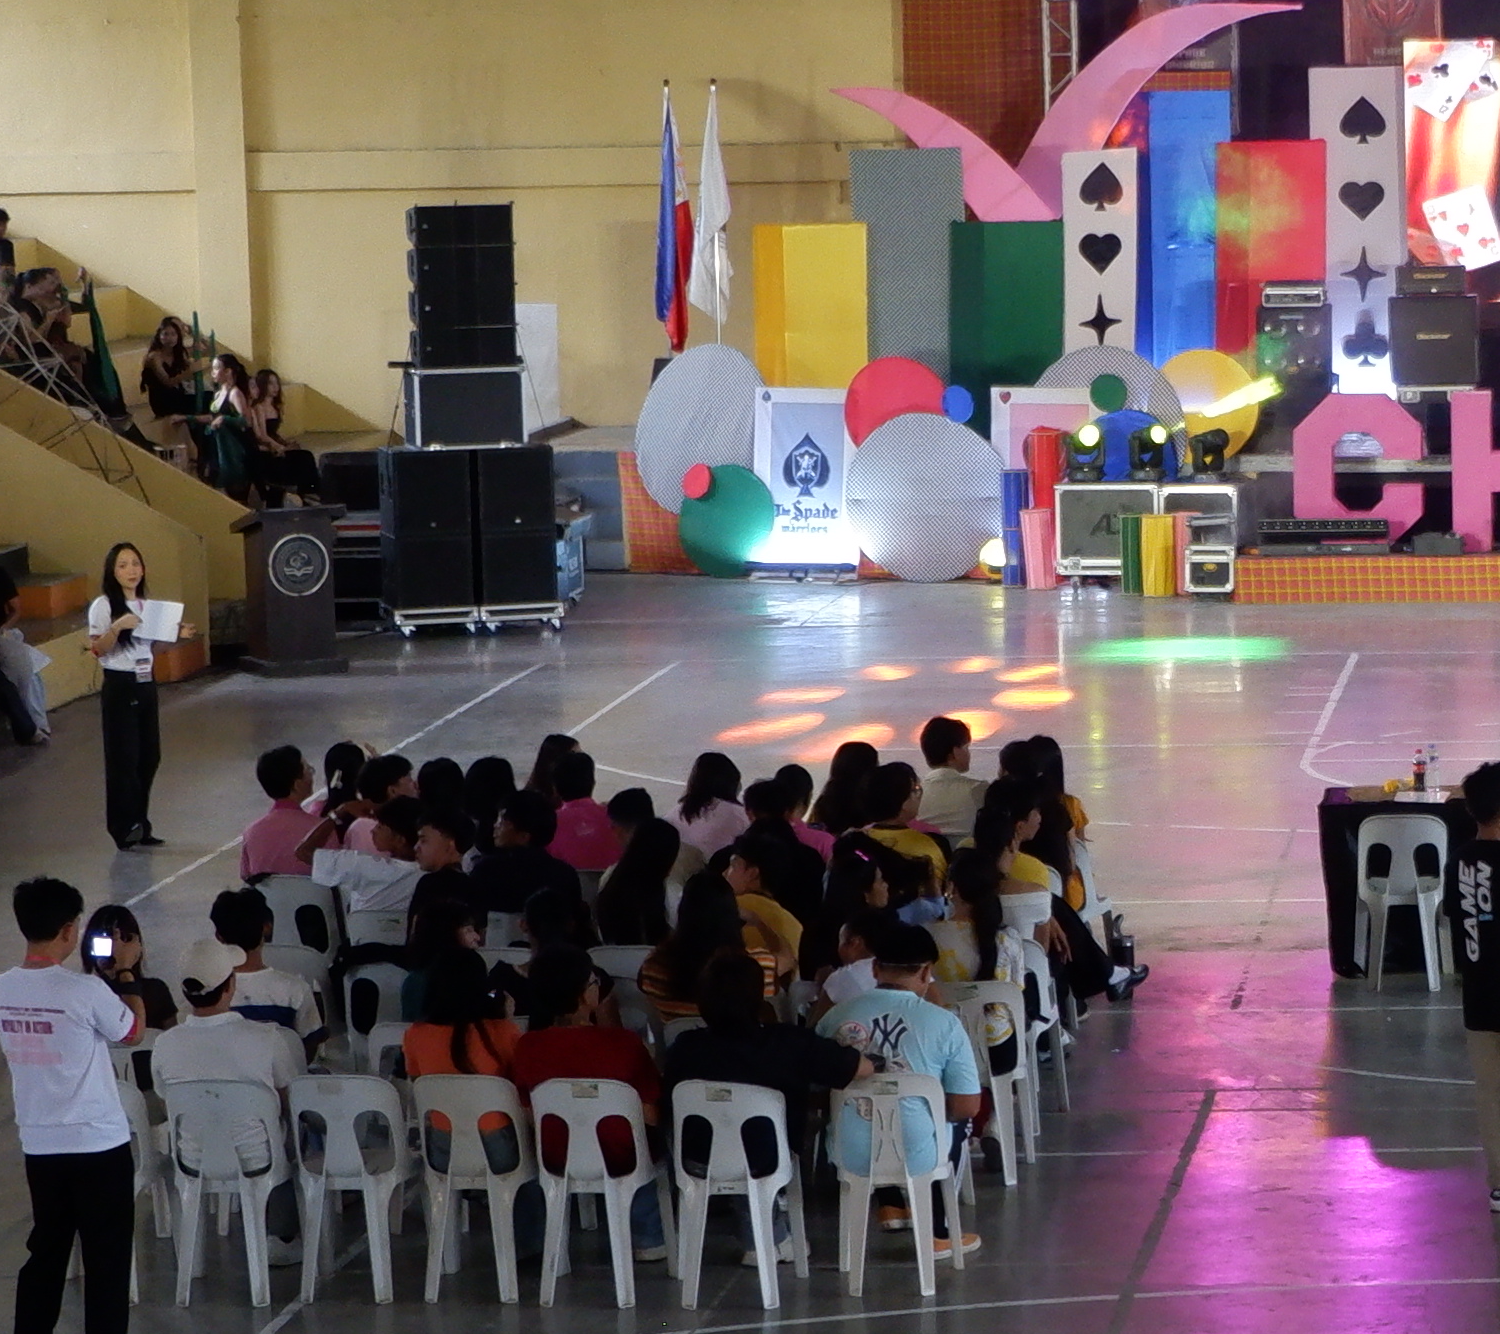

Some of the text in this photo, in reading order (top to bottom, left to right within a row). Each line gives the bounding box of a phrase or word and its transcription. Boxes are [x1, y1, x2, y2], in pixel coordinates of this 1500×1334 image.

[790, 499, 839, 522] Spade
[1458, 860, 1480, 963] GAME
[1476, 860, 1493, 914] ON
